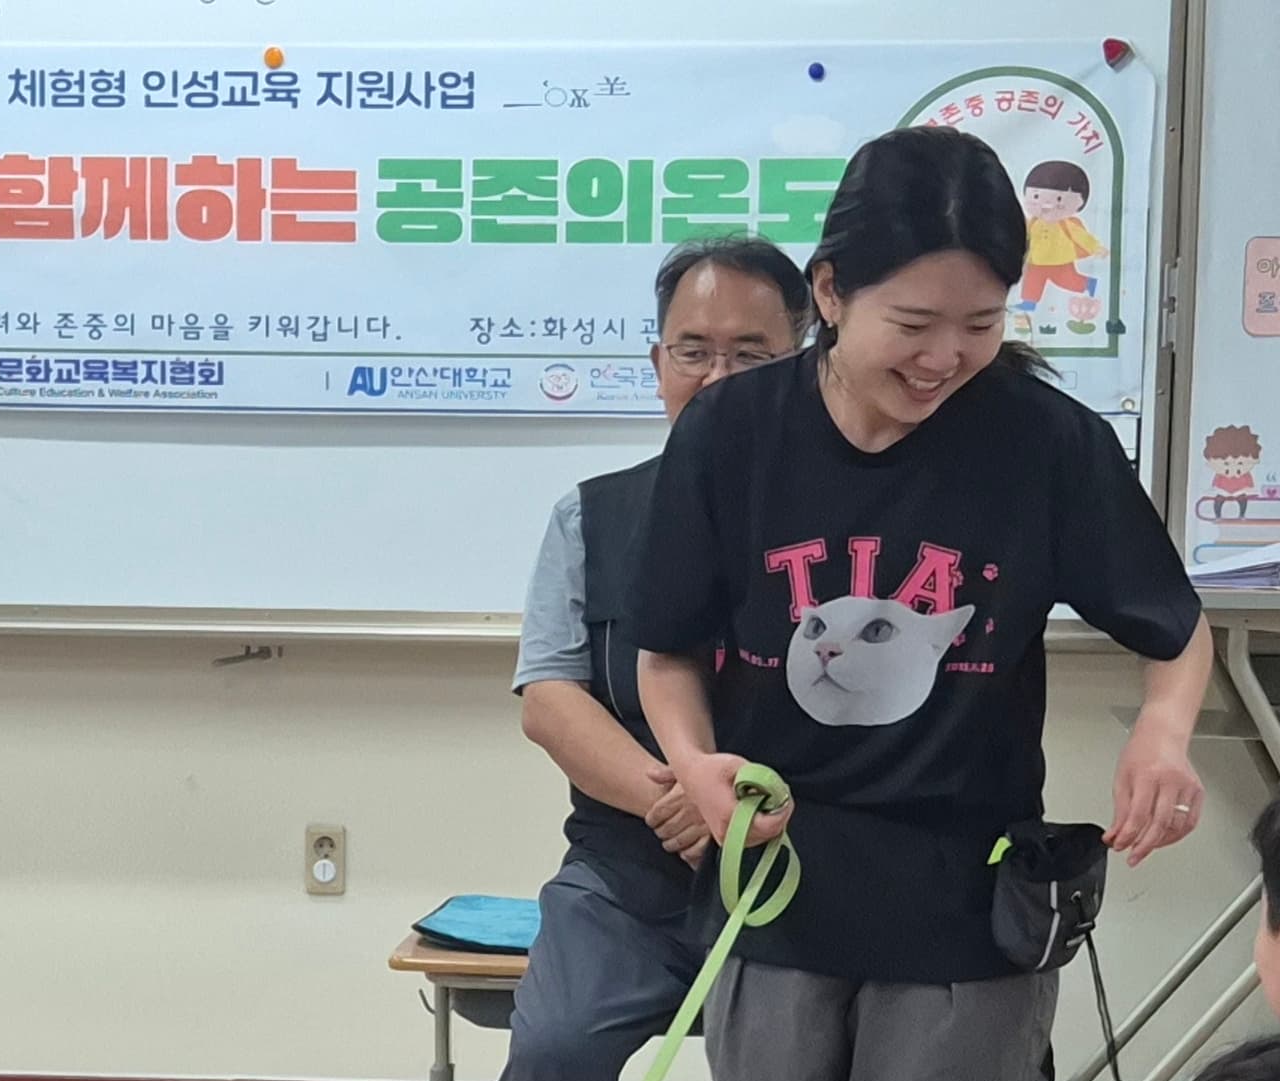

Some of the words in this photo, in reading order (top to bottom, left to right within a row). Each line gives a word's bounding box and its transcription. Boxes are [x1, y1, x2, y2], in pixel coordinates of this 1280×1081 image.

[7, 68, 127, 107] 체험형
[142, 70, 302, 109] 인성교육
[316, 71, 476, 110] 지원사업
[994, 89, 1065, 121] 공존의
[53, 311, 136, 341] 존중의
[151, 313, 235, 342] 마음을
[247, 314, 403, 343] 키워갑니다.
[39, 387, 96, 399] Education
[153, 388, 219, 400] Association
[347, 366, 388, 397] AU
[390, 366, 513, 389] 안산대학교
[764, 536, 962, 623] TIA
